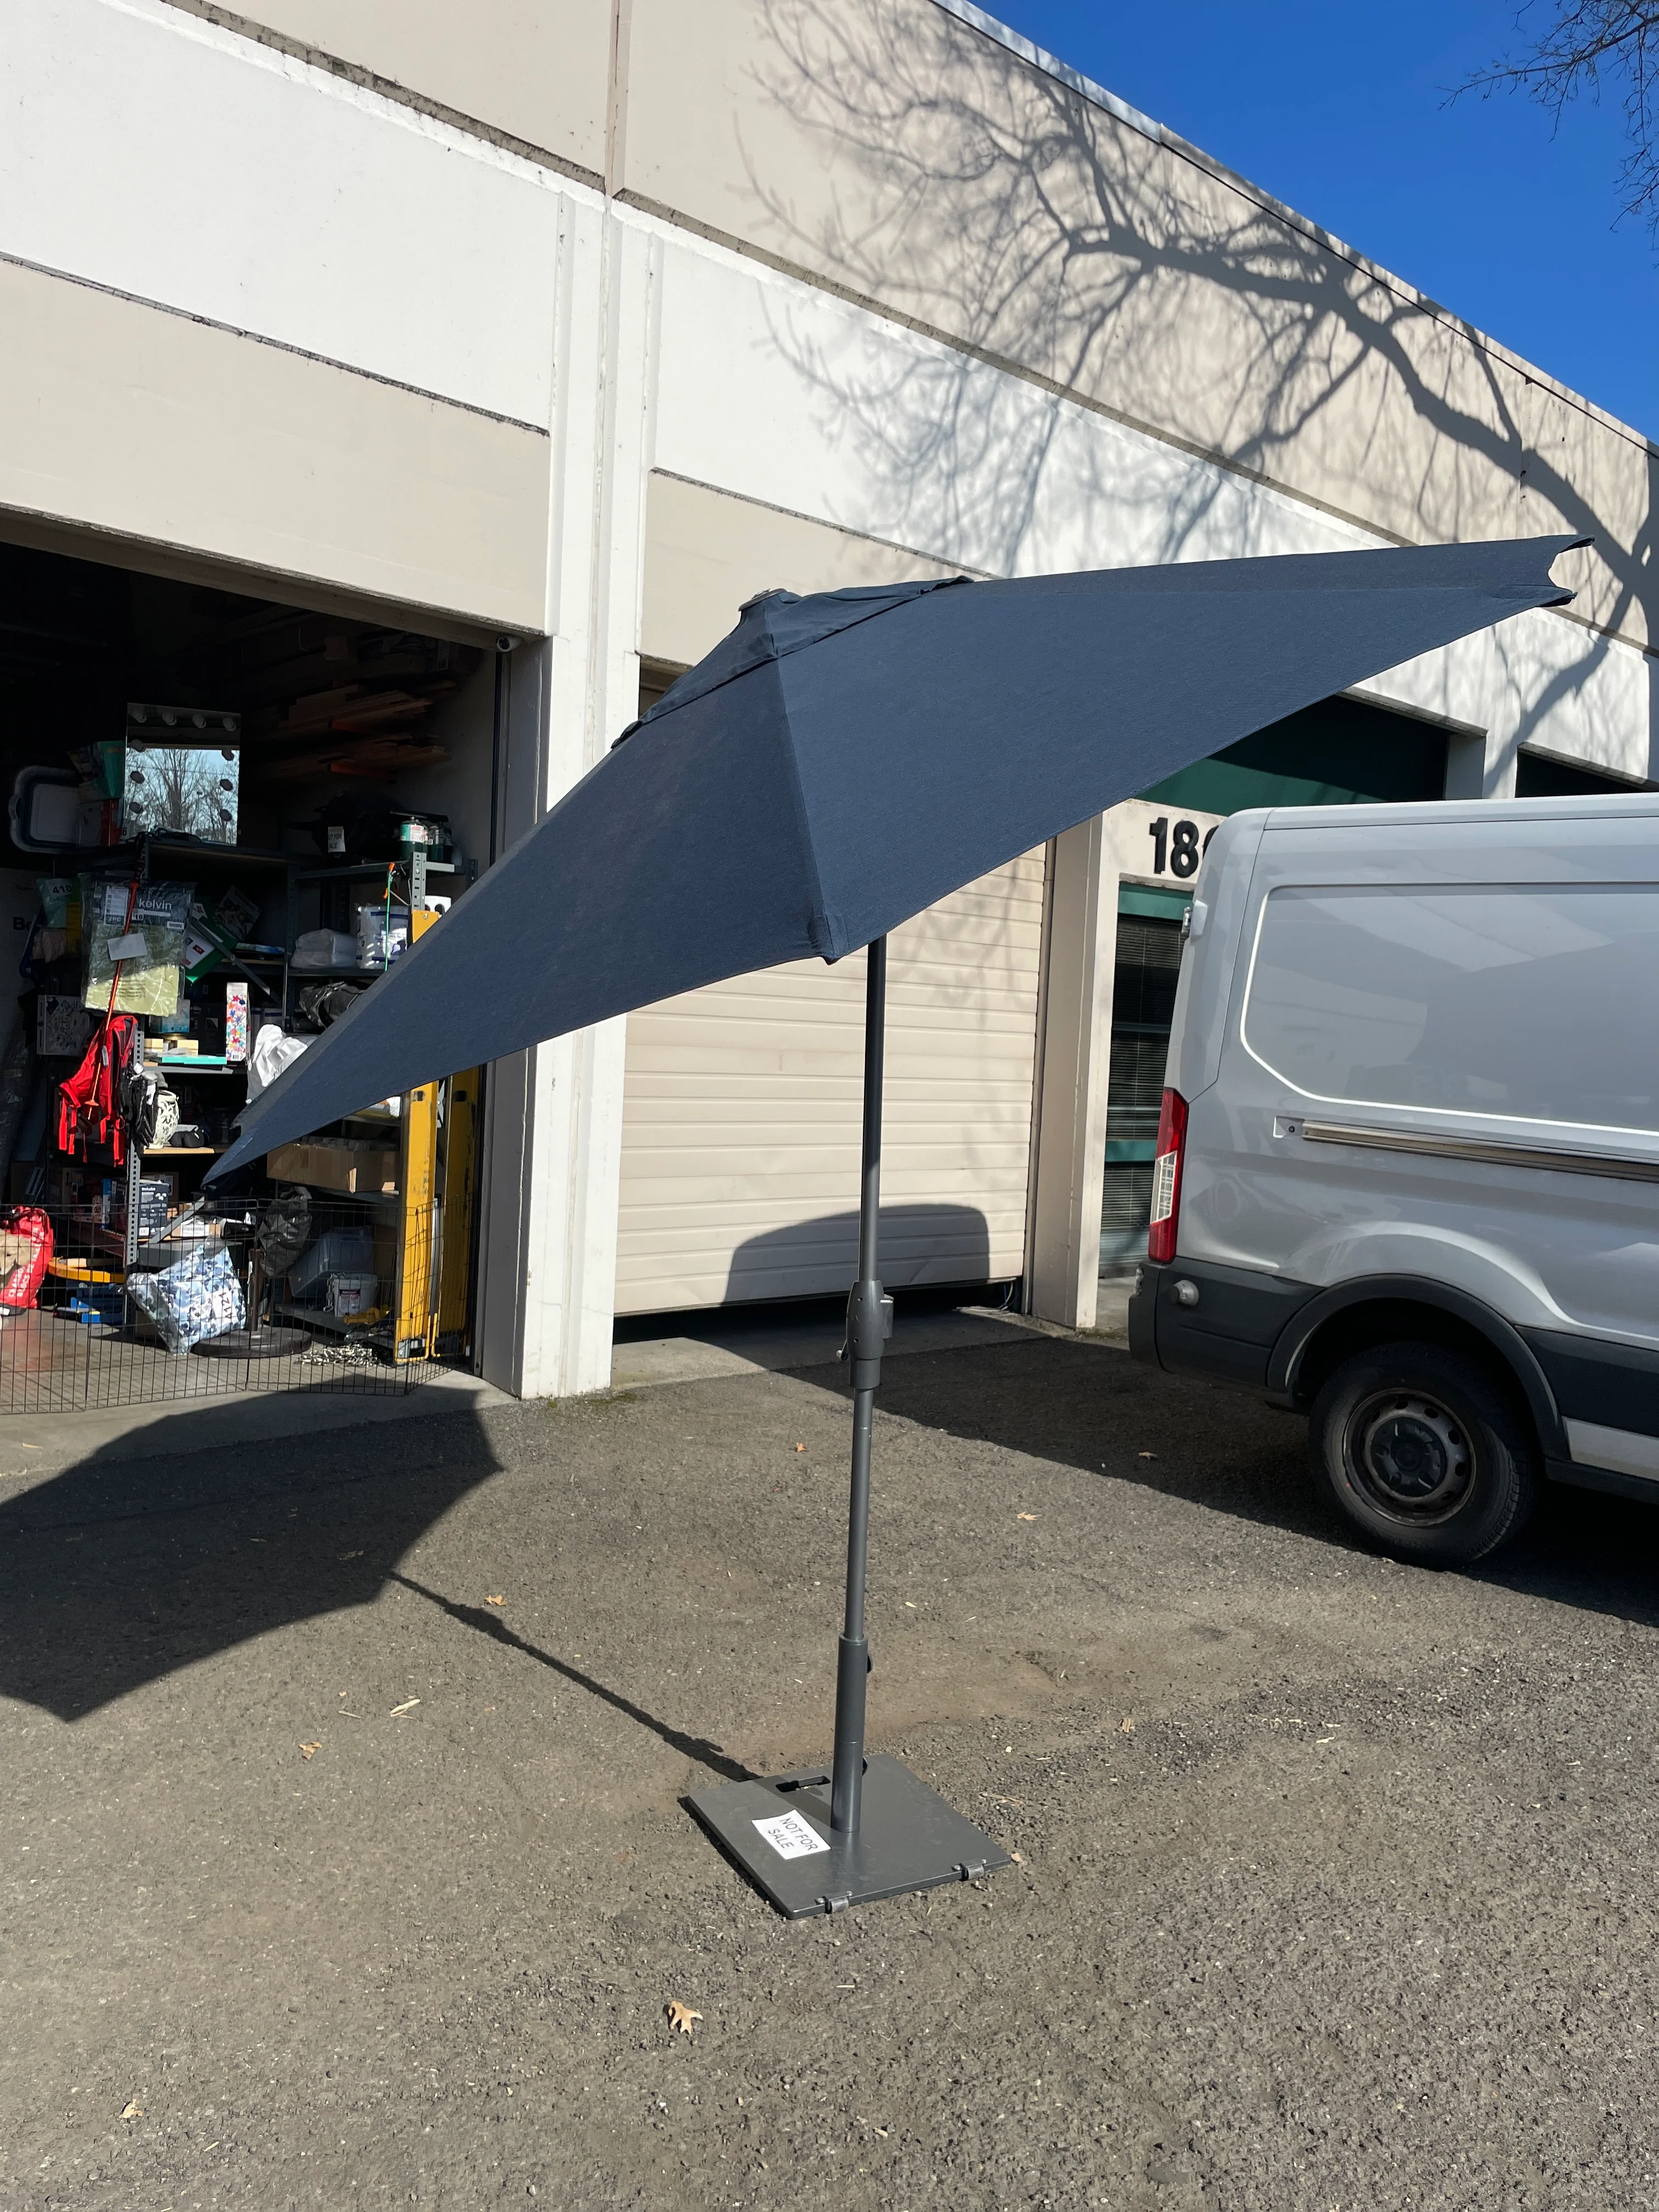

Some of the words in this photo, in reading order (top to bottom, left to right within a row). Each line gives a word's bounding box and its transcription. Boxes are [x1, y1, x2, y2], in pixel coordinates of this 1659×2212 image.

[139, 898, 172, 910] kelvin
[768, 1828, 795, 1849] SALE
[779, 1817, 803, 1833] NOT
[794, 1833, 818, 1851] FOR
